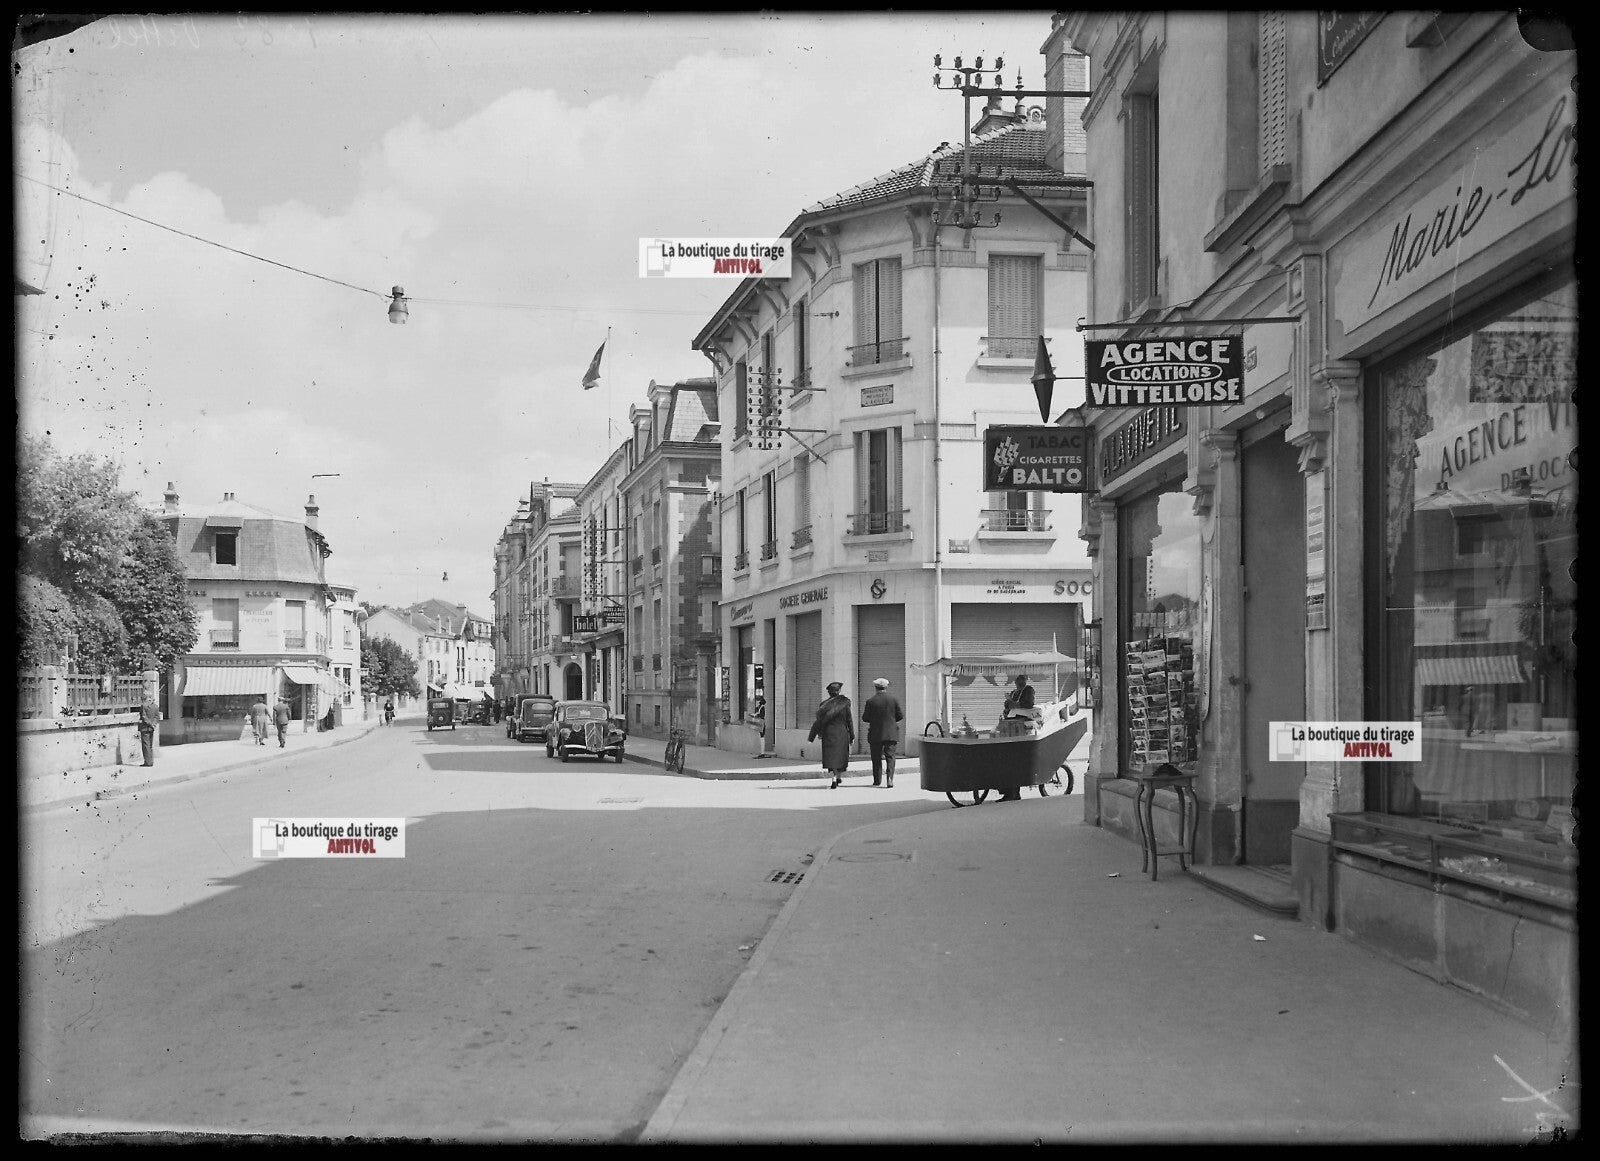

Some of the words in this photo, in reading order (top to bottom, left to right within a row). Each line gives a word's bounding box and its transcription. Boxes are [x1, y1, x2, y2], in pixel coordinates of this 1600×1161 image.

[1100, 339, 1230, 368] AGENCE
[1120, 365, 1213, 381] LOCATIONS
[1090, 377, 1240, 406] VITTELLOISE
[1029, 436, 1082, 449] TABAC
[1112, 430, 1126, 472] LA
[1440, 404, 1526, 482] AGENCE
[1019, 455, 1082, 465] CIGARETTES
[1012, 468, 1082, 485] BALTO
[1054, 580, 1093, 596] SOC
